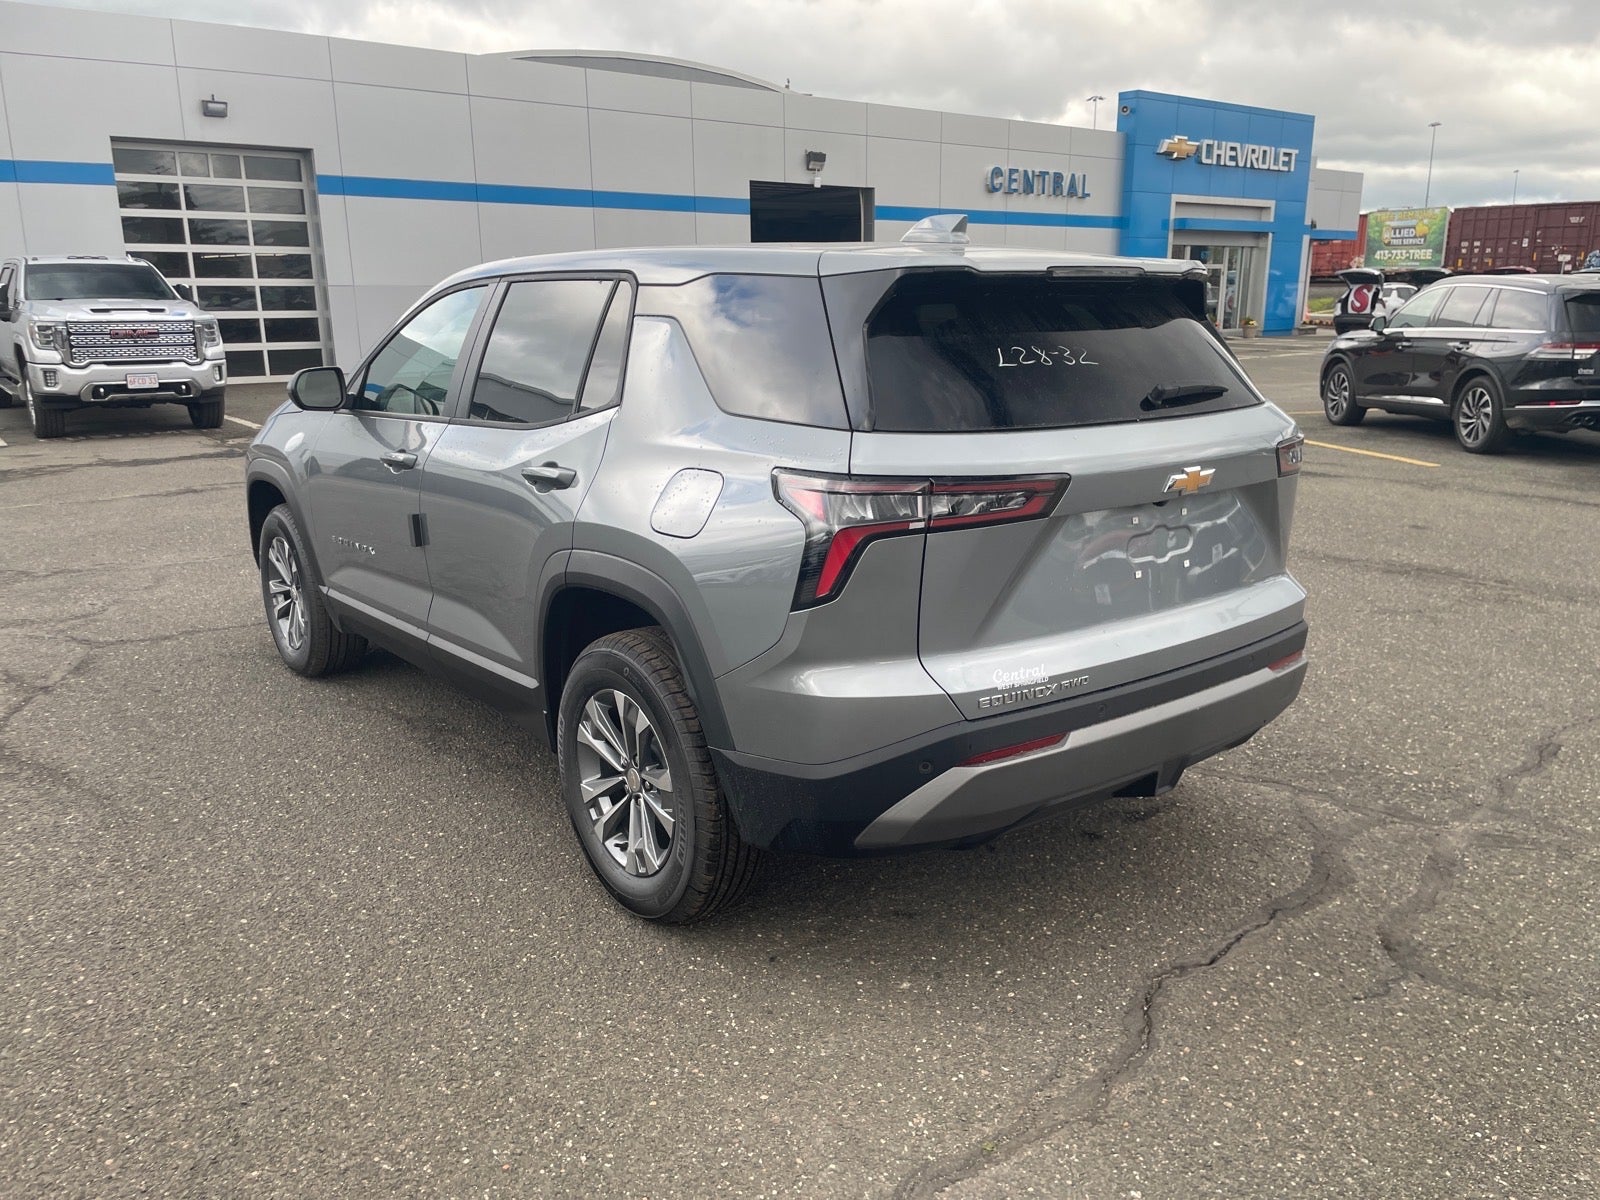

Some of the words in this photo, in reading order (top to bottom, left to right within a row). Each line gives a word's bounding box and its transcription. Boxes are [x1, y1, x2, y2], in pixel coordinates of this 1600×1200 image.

[1199, 139, 1299, 172] CHEVROLET
[986, 166, 1091, 199] CENTRAL
[110, 329, 159, 339] GMC
[997, 345, 1099, 367] L28-32
[992, 663, 1047, 683] Central
[978, 683, 1058, 708] EQUINOX
[1060, 675, 1089, 690] AWD
